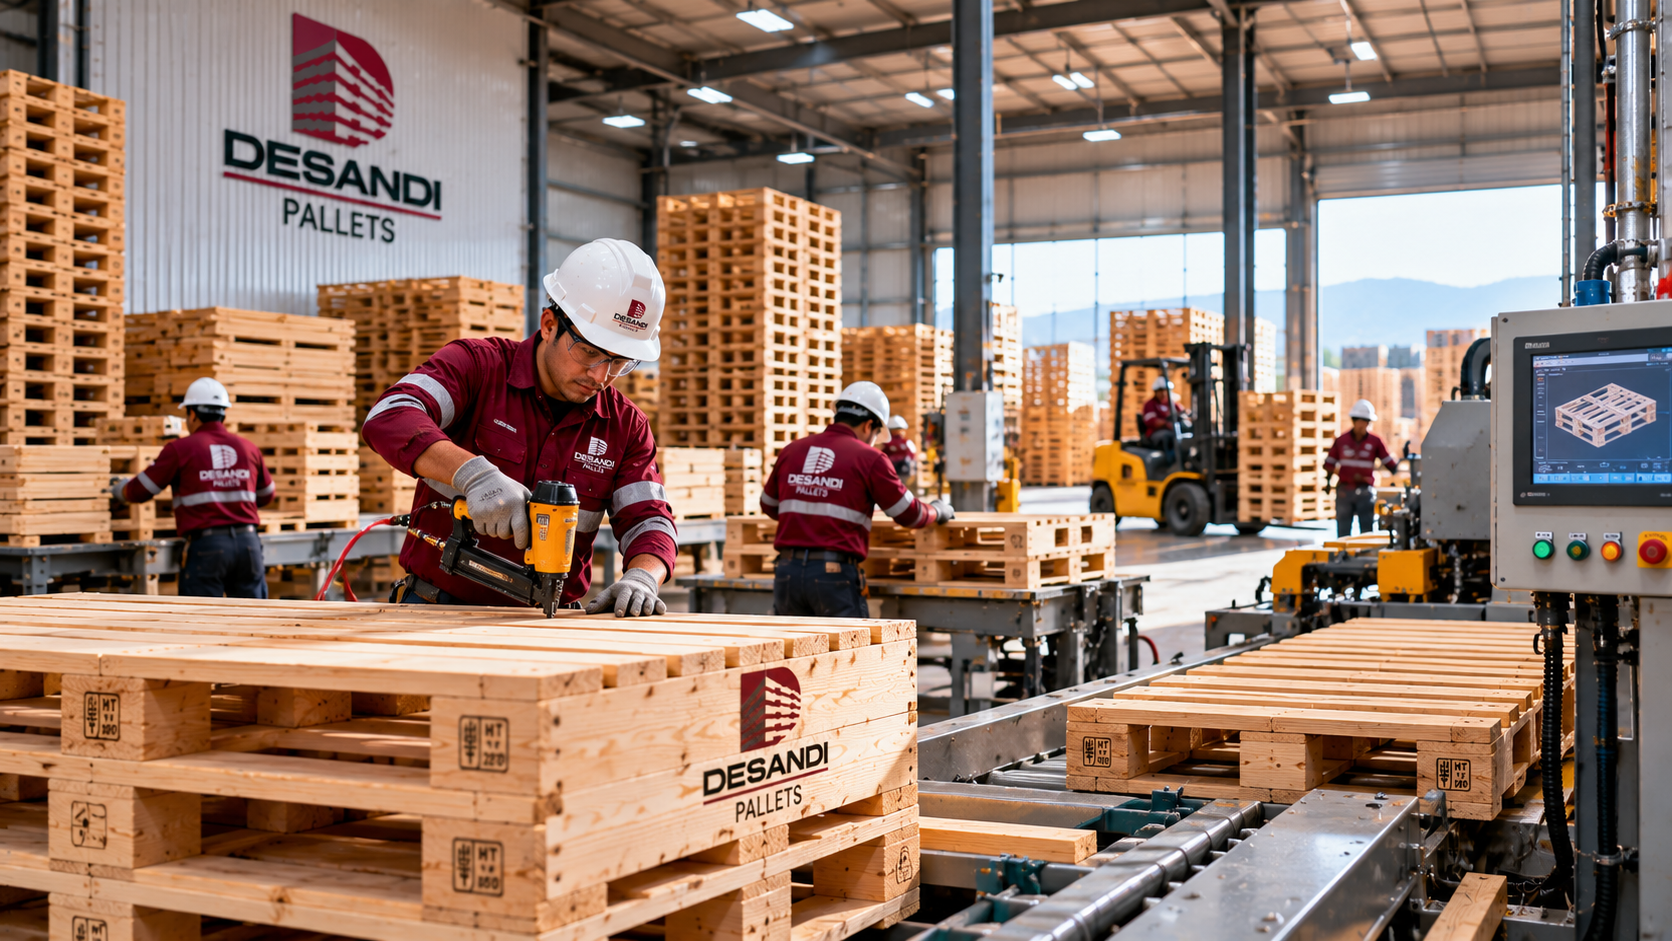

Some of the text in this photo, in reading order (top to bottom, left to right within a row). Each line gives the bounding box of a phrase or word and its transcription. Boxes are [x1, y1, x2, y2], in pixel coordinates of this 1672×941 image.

[224, 129, 442, 211] DESANDI
[283, 198, 395, 243] PALLETS
[199, 469, 250, 481] DESANDI
[787, 473, 844, 489] DESANDI
[703, 741, 829, 797] DESANDI
[735, 784, 802, 823] PALLETS
